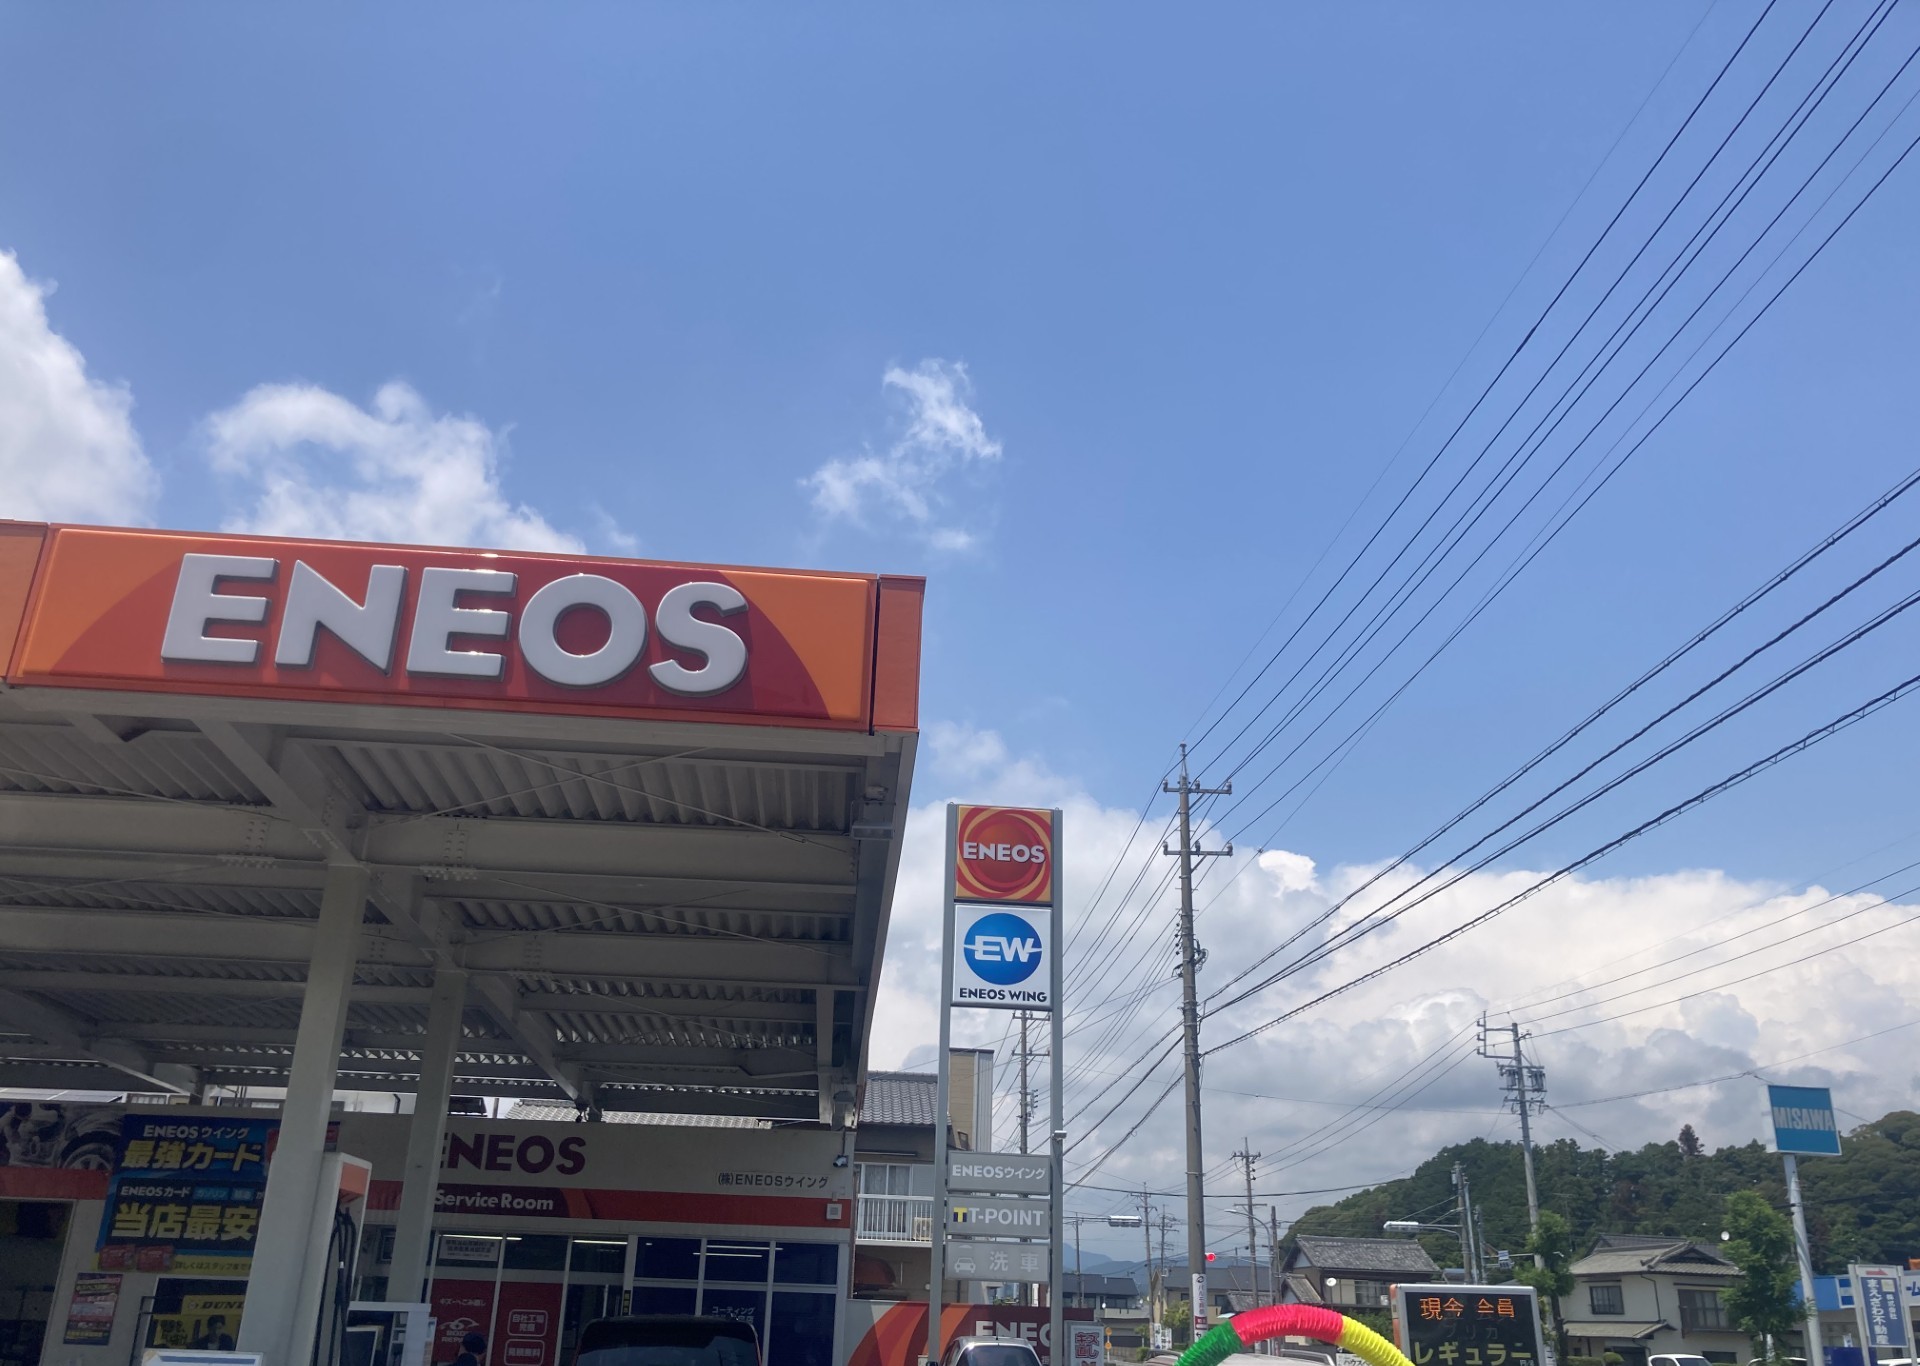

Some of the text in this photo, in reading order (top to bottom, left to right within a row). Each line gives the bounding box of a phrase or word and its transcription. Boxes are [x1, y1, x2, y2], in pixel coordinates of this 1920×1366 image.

[159, 552, 750, 697] ENEOS
[963, 842, 1046, 864] ENEOS
[974, 935, 1035, 963] EW
[959, 987, 1048, 1003] ENEOS WING
[1773, 1106, 1836, 1132] MISAWA
[143, 1124, 250, 1139] ENEOSウイング
[121, 1140, 262, 1172] 最強カード
[952, 1164, 1047, 1180] ENEOSウイング
[435, 1188, 554, 1210] Service Room
[112, 1203, 260, 1240] 当店最安
[969, 1208, 1045, 1226] T-POINT
[989, 1251, 1039, 1273] 洗車
[1414, 1342, 1531, 1366] レギュラー
